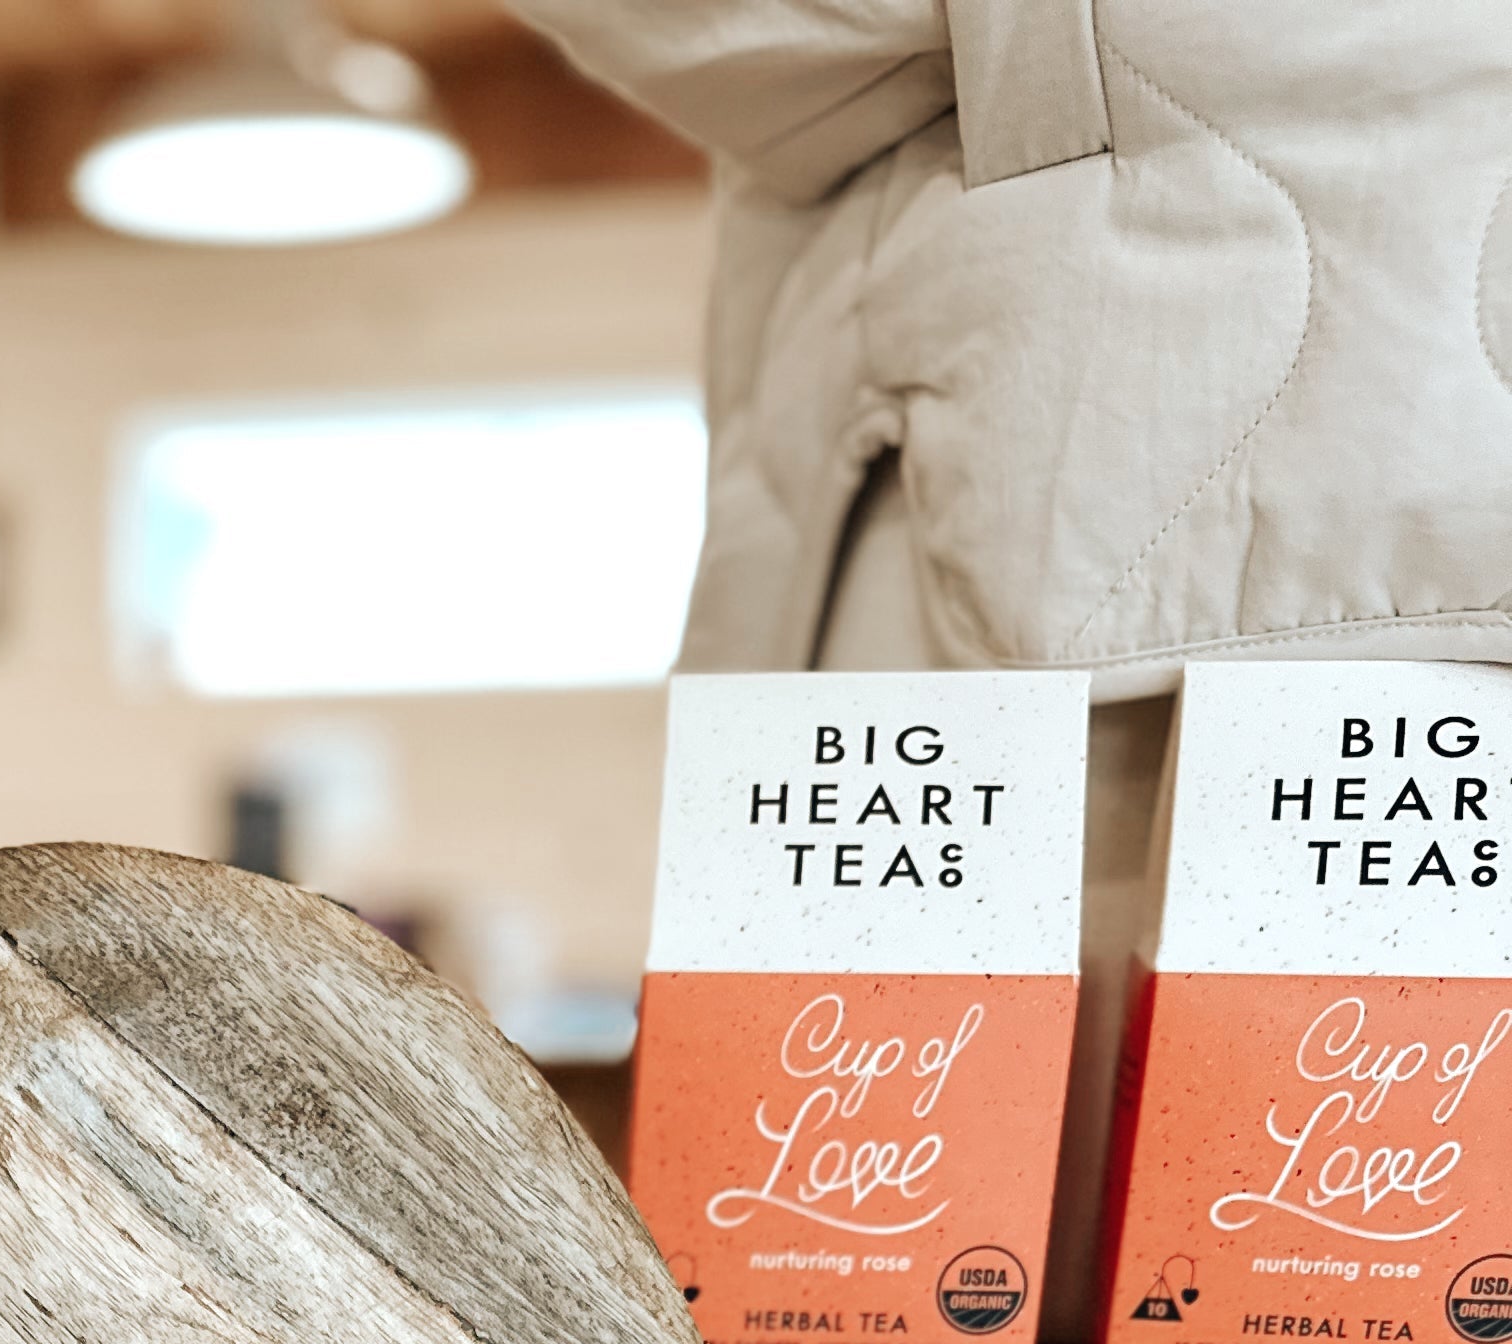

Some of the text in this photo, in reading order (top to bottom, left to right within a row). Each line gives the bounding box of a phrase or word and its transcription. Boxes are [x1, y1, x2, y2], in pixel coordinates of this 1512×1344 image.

[815, 725, 945, 766] BIG
[1341, 716, 1480, 758] BIG
[750, 783, 1005, 825] HEART
[1271, 777, 1512, 821] HEAR
[781, 994, 984, 1118] Cup of
[1296, 996, 1512, 1125] Cup of
[705, 1086, 951, 1235] Love
[1209, 1090, 1469, 1242] Love
[750, 1250, 911, 1276] nurturing rose
[959, 1267, 1008, 1287] USDA
[1251, 1255, 1421, 1282] nurturing rose
[949, 1293, 1013, 1312] ORGANIC
[1470, 1275, 1512, 1296] USD
[744, 1310, 909, 1335] HERBAL TEA
[1148, 1302, 1167, 1318] 10
[1242, 1313, 1414, 1342] HERBAL TEA
